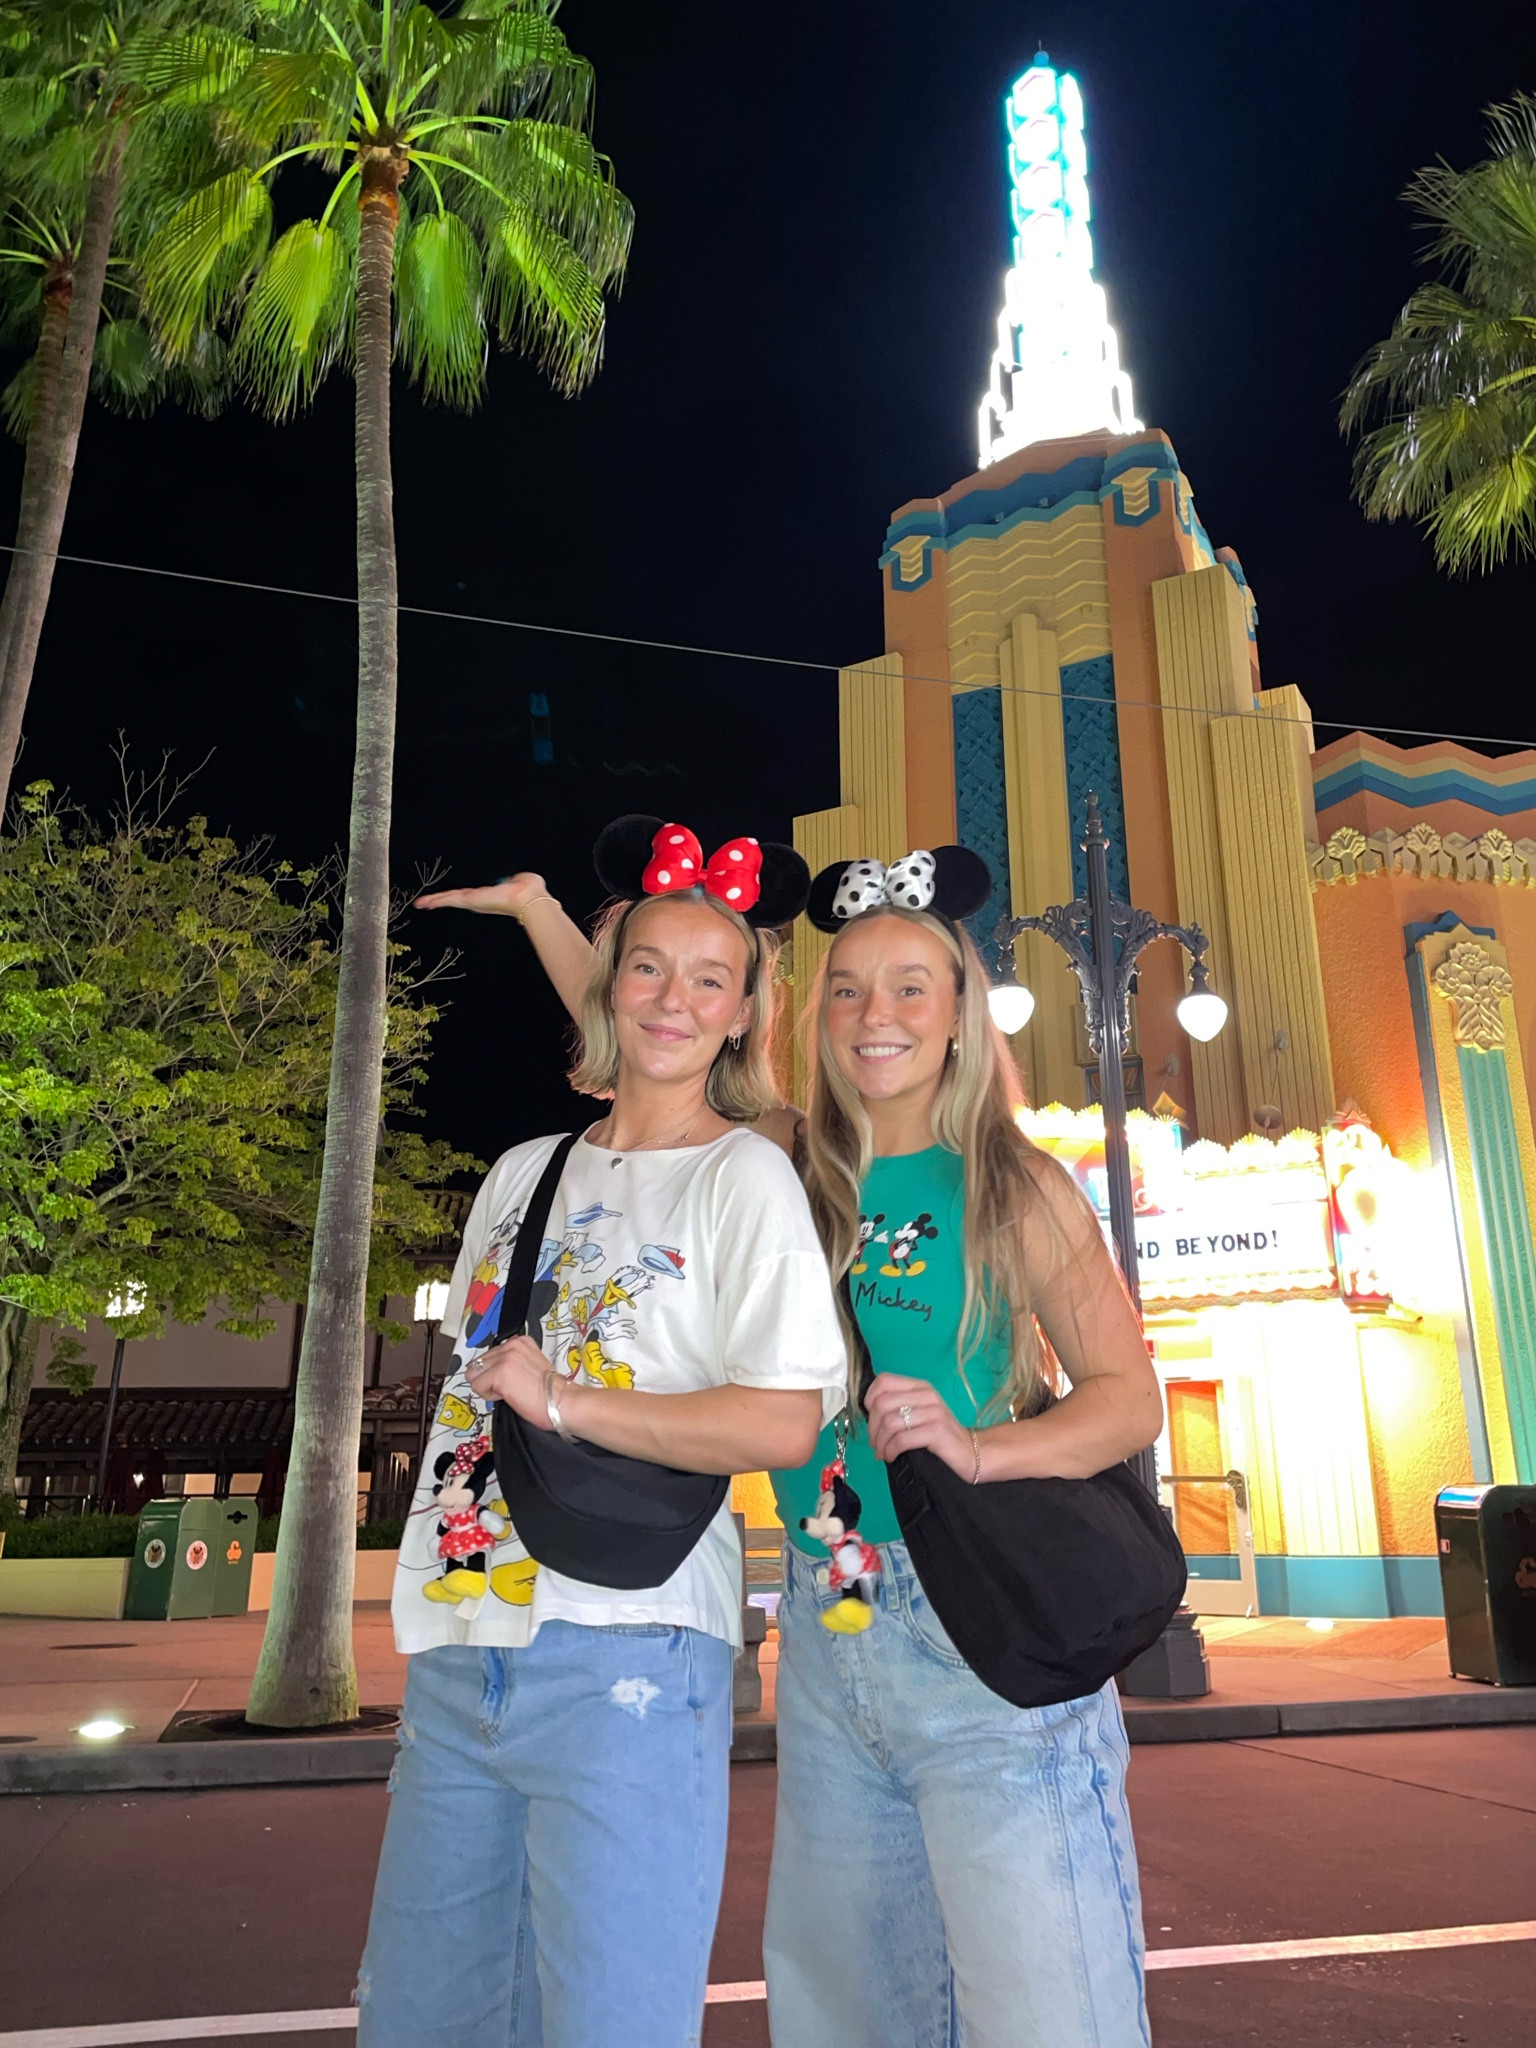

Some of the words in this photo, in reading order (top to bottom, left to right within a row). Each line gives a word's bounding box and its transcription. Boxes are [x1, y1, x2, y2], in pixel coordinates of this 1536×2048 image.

[1136, 1241, 1160, 1259] ND
[1175, 1230, 1278, 1256] BEYOND!
[855, 1281, 932, 1322] Mickey
